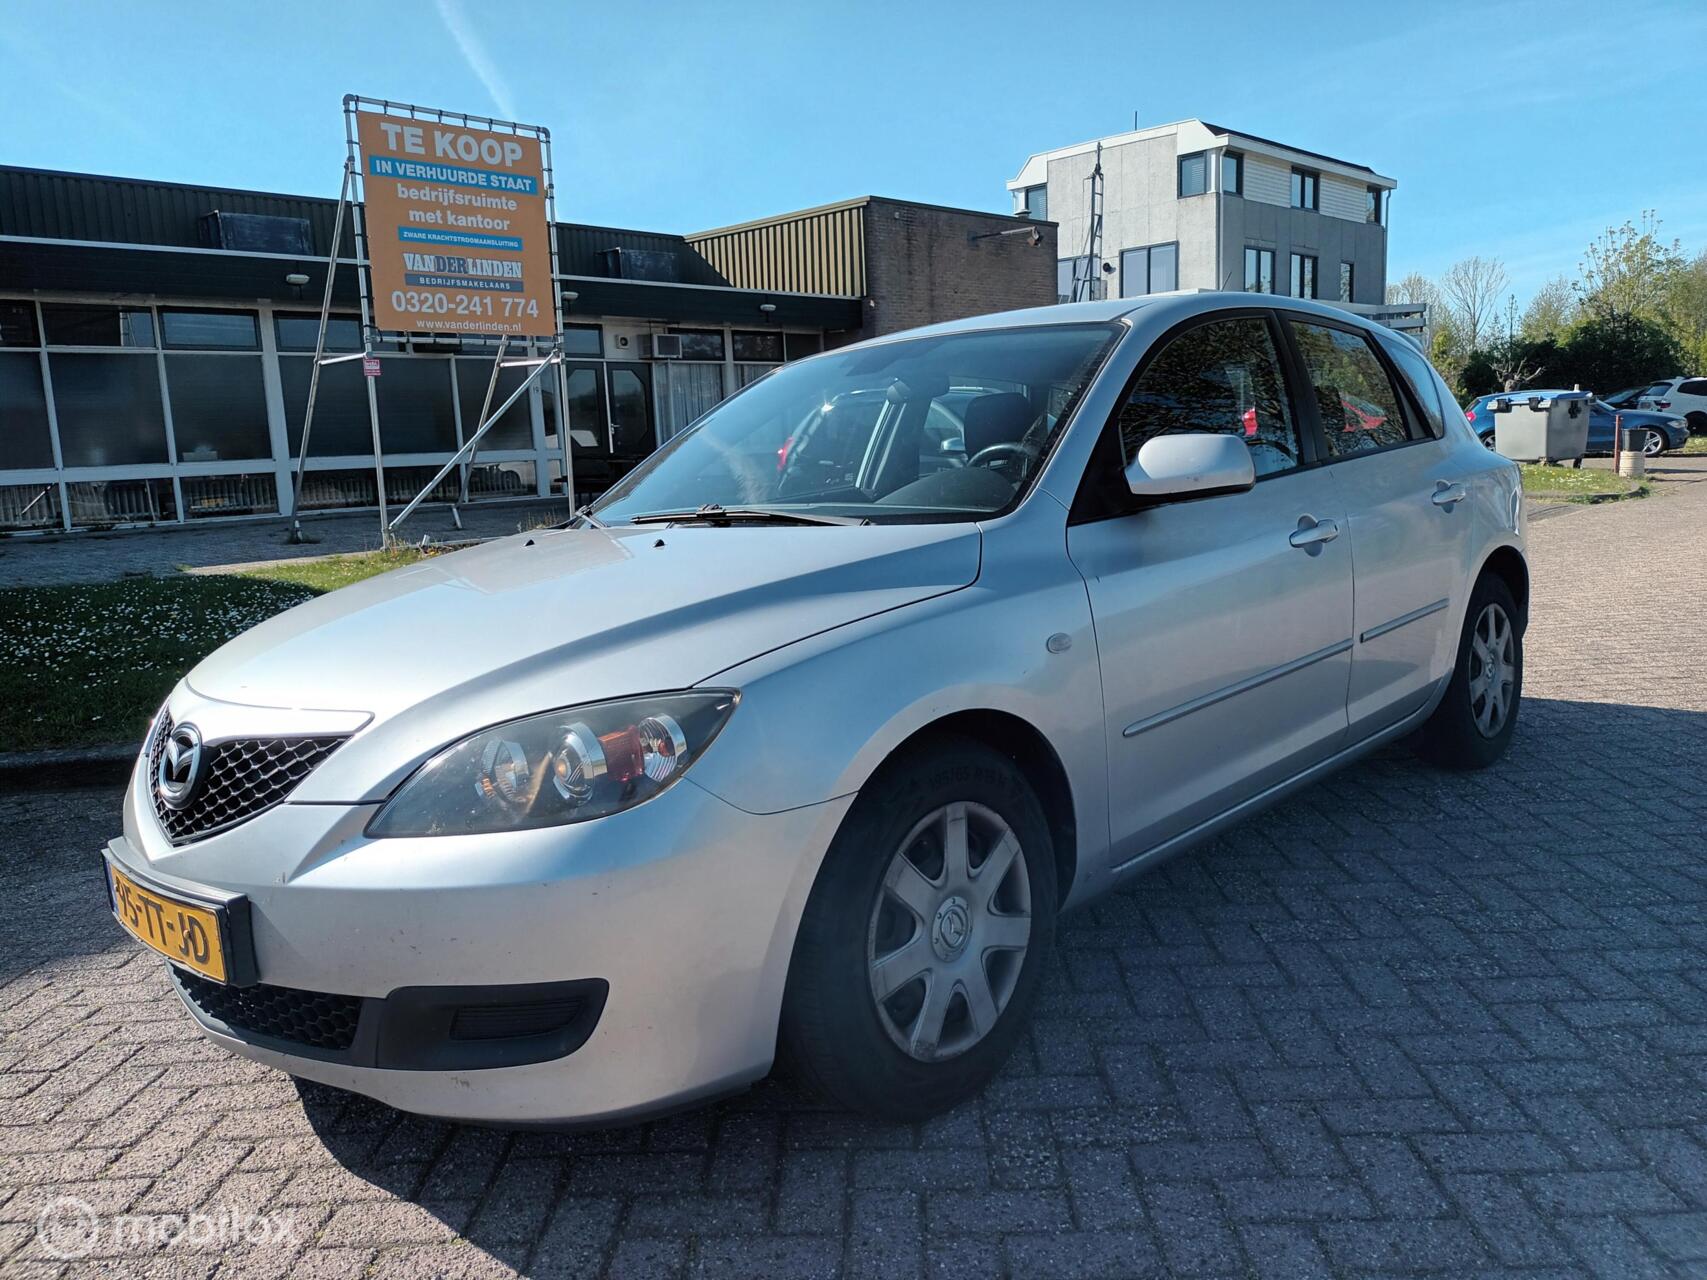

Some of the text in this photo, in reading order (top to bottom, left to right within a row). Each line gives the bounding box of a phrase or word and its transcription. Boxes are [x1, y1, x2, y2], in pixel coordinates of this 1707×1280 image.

[380, 122, 523, 167] TE KOOP
[376, 159, 531, 191] IN VERHUURDE STAAT
[397, 183, 518, 211] bedrijfsruimte
[409, 210, 510, 231] met kantoor
[403, 231, 427, 240] ZWARE
[419, 276, 511, 290] BEDRIJFSMAKELAARS
[391, 290, 539, 318] 0320-241 774
[416, 319, 522, 332] www.vanderlinden.nl
